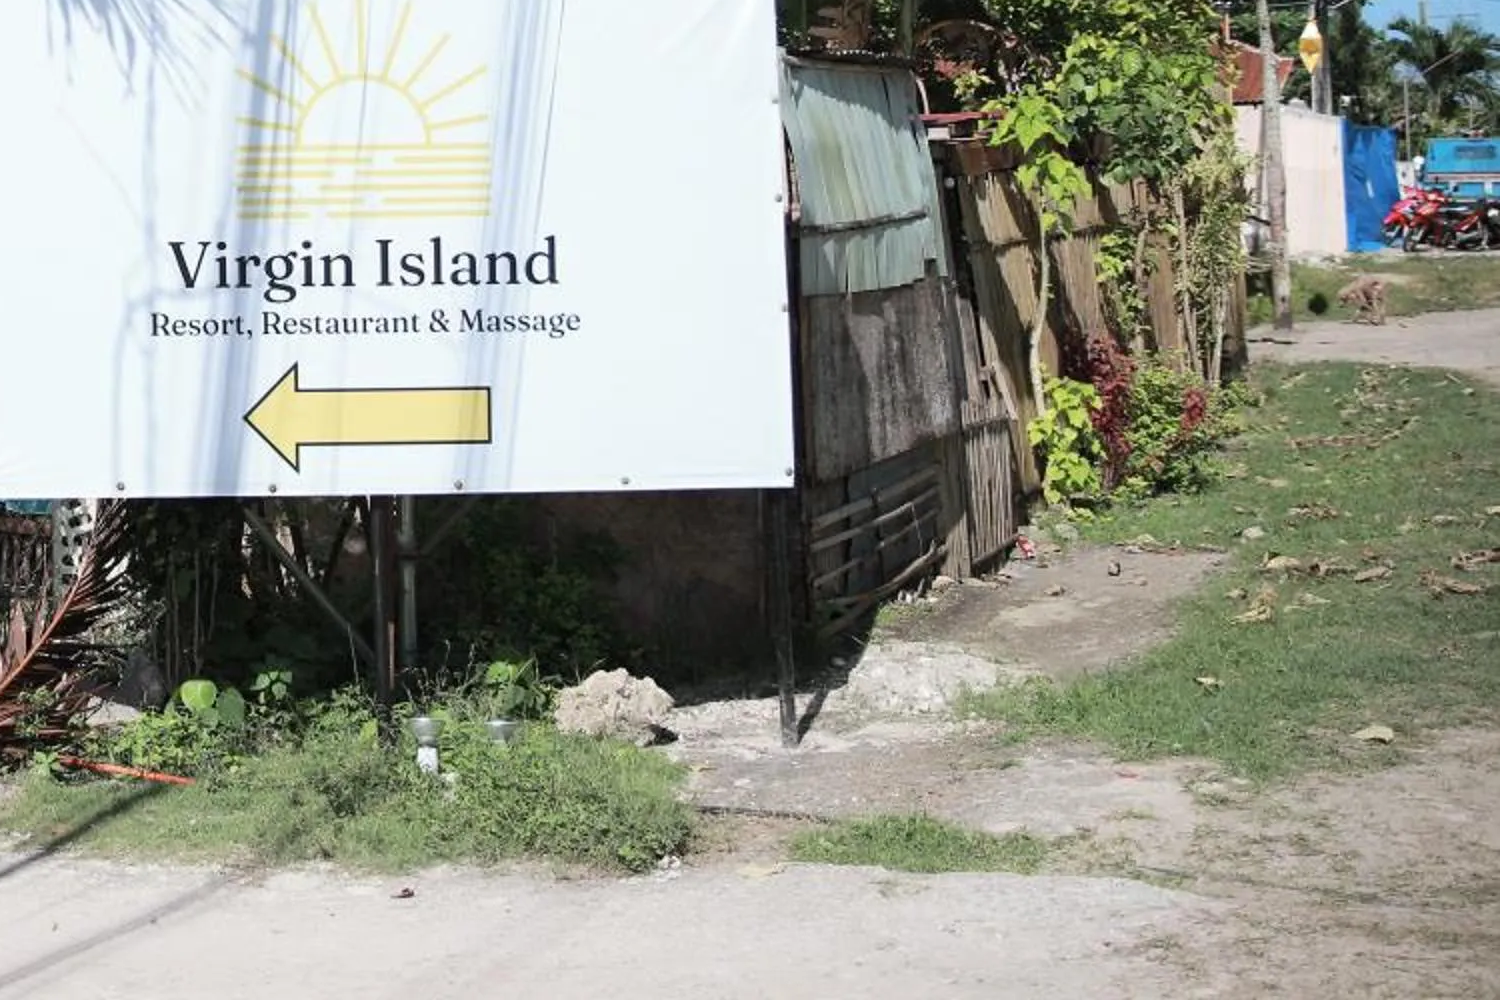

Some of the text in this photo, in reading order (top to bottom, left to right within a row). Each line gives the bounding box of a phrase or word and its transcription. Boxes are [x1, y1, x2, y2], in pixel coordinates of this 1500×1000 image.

[168, 235, 559, 303] Virgin Island
[151, 309, 581, 338] Resort, Restaurant & Massage
